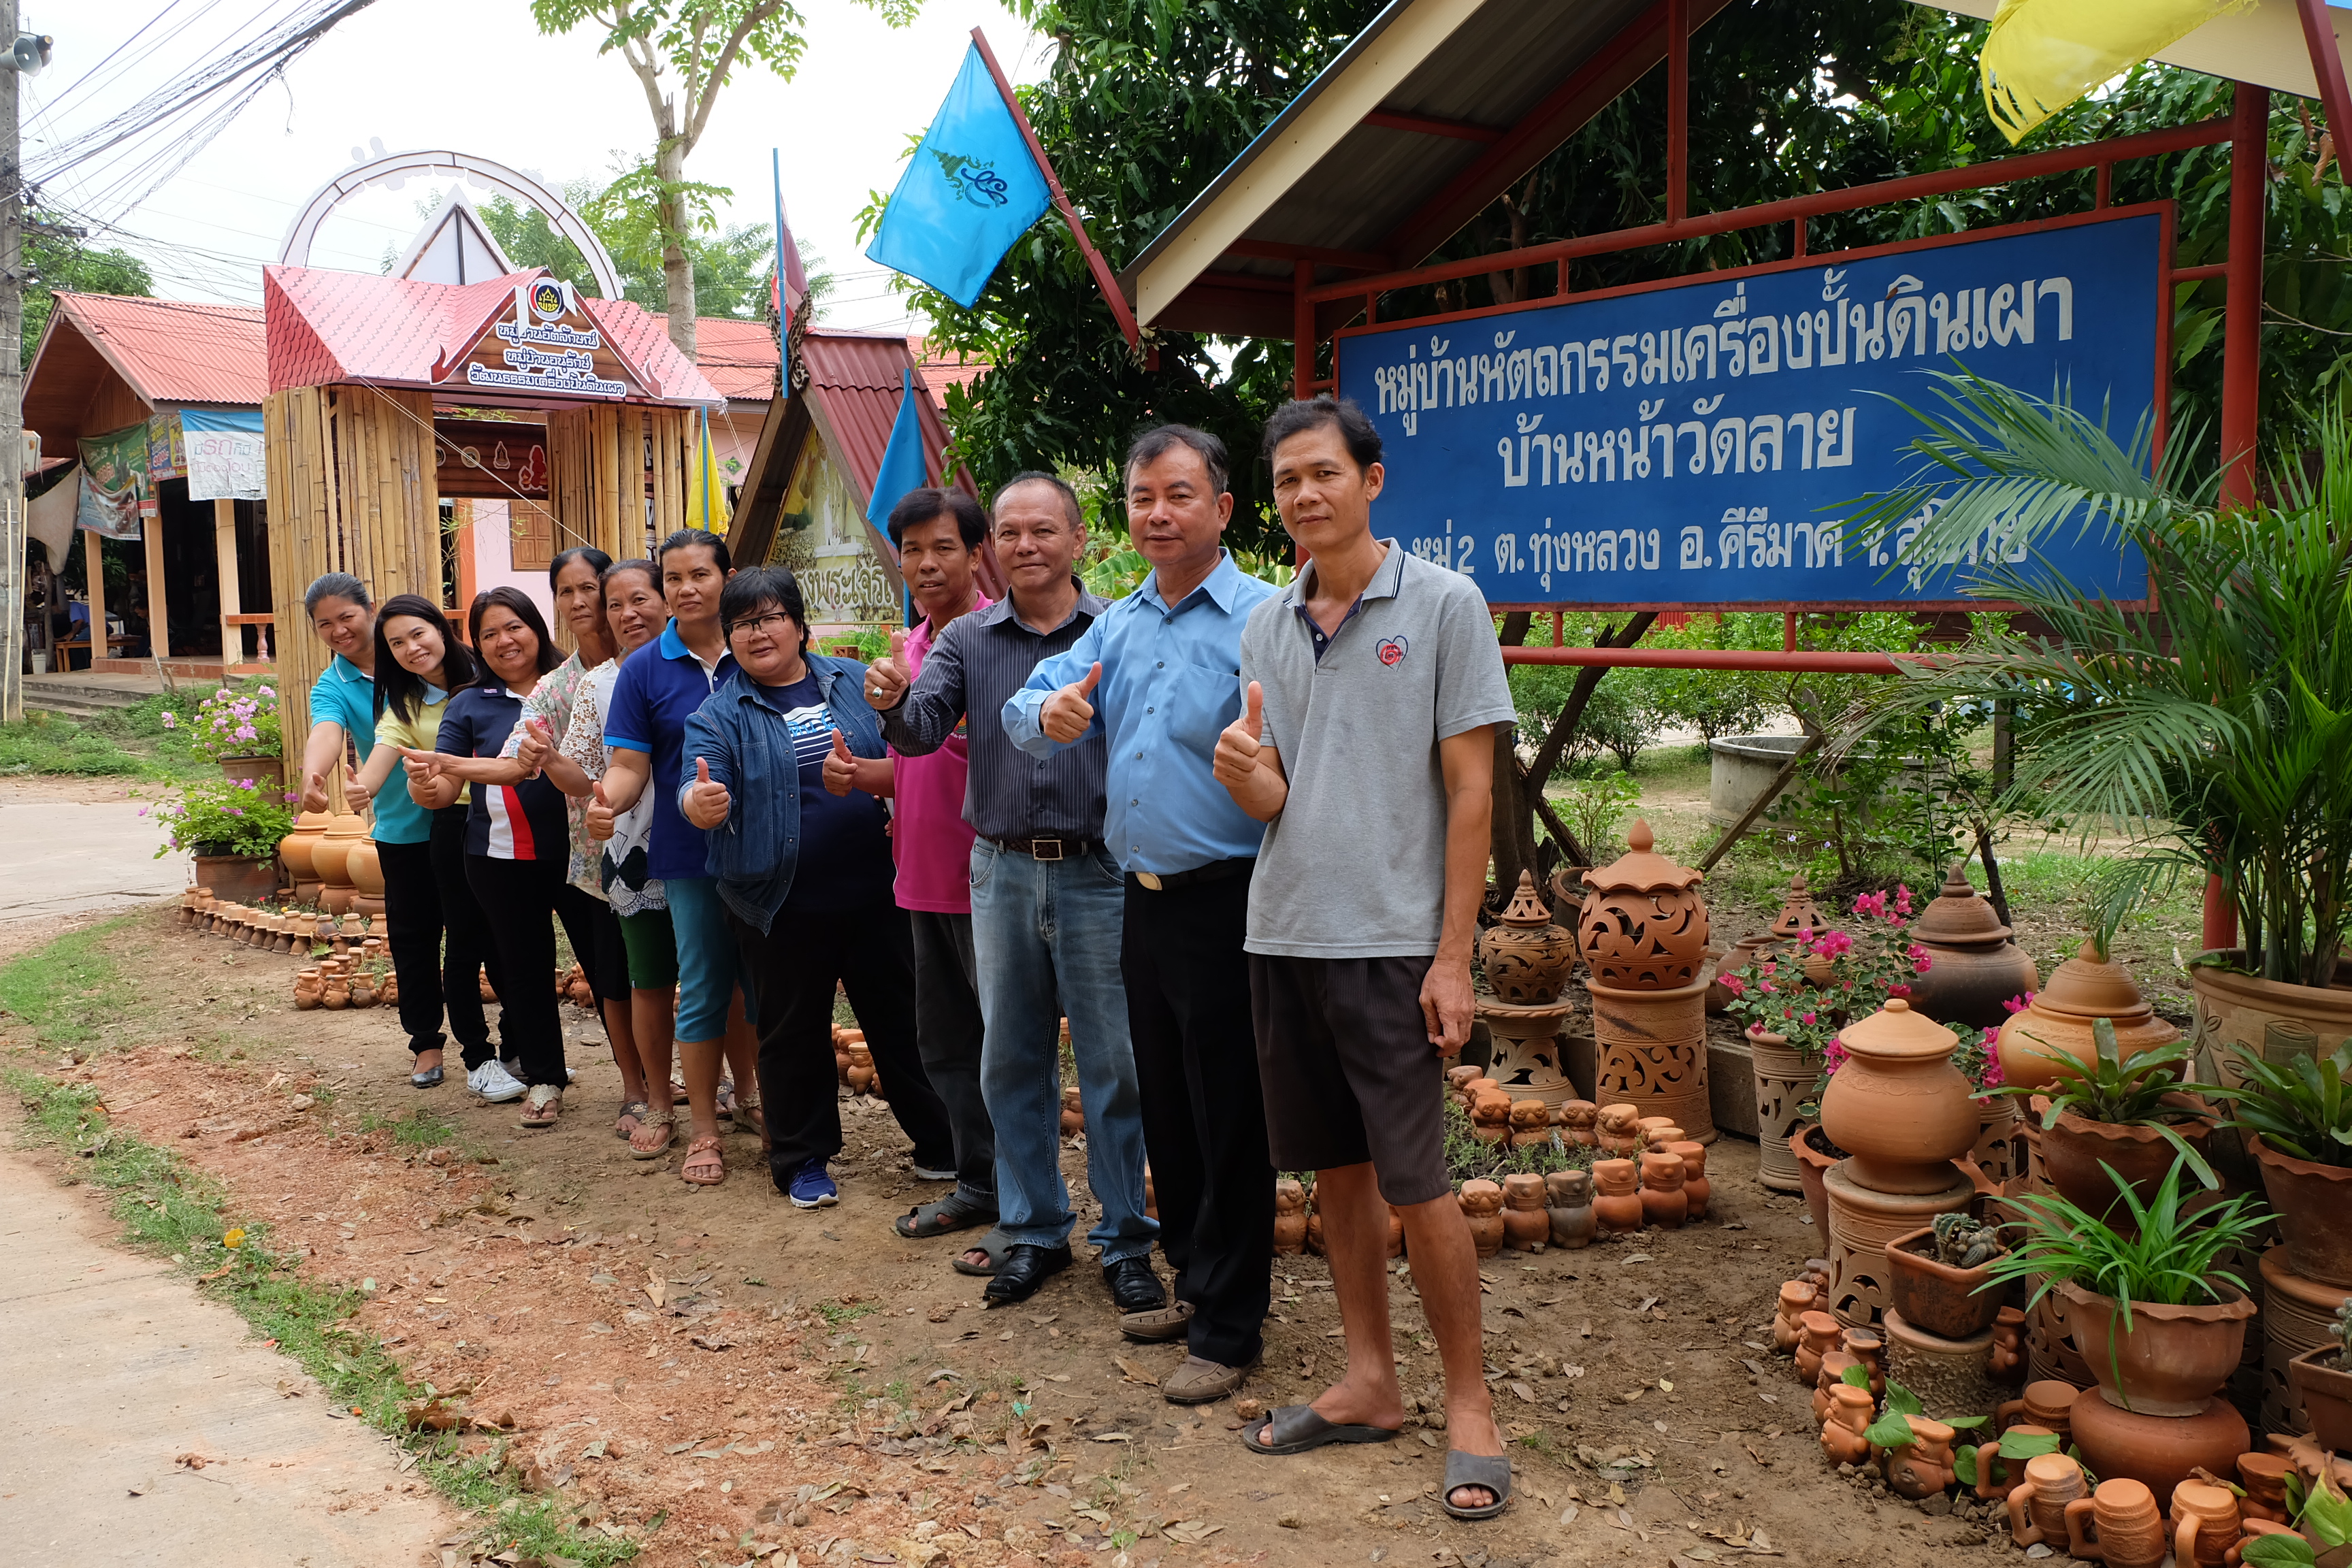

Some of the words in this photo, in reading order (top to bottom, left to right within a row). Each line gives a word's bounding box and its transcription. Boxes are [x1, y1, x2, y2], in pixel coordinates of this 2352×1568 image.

[506, 348, 591, 373] หมู่บ้านอนุรักษ์
[1375, 267, 2073, 436] หมู่บ้านหัตถกรรมเครื่องปั้นดินเผา
[1497, 394, 1857, 487] บ้านหน้าวัดลาย
